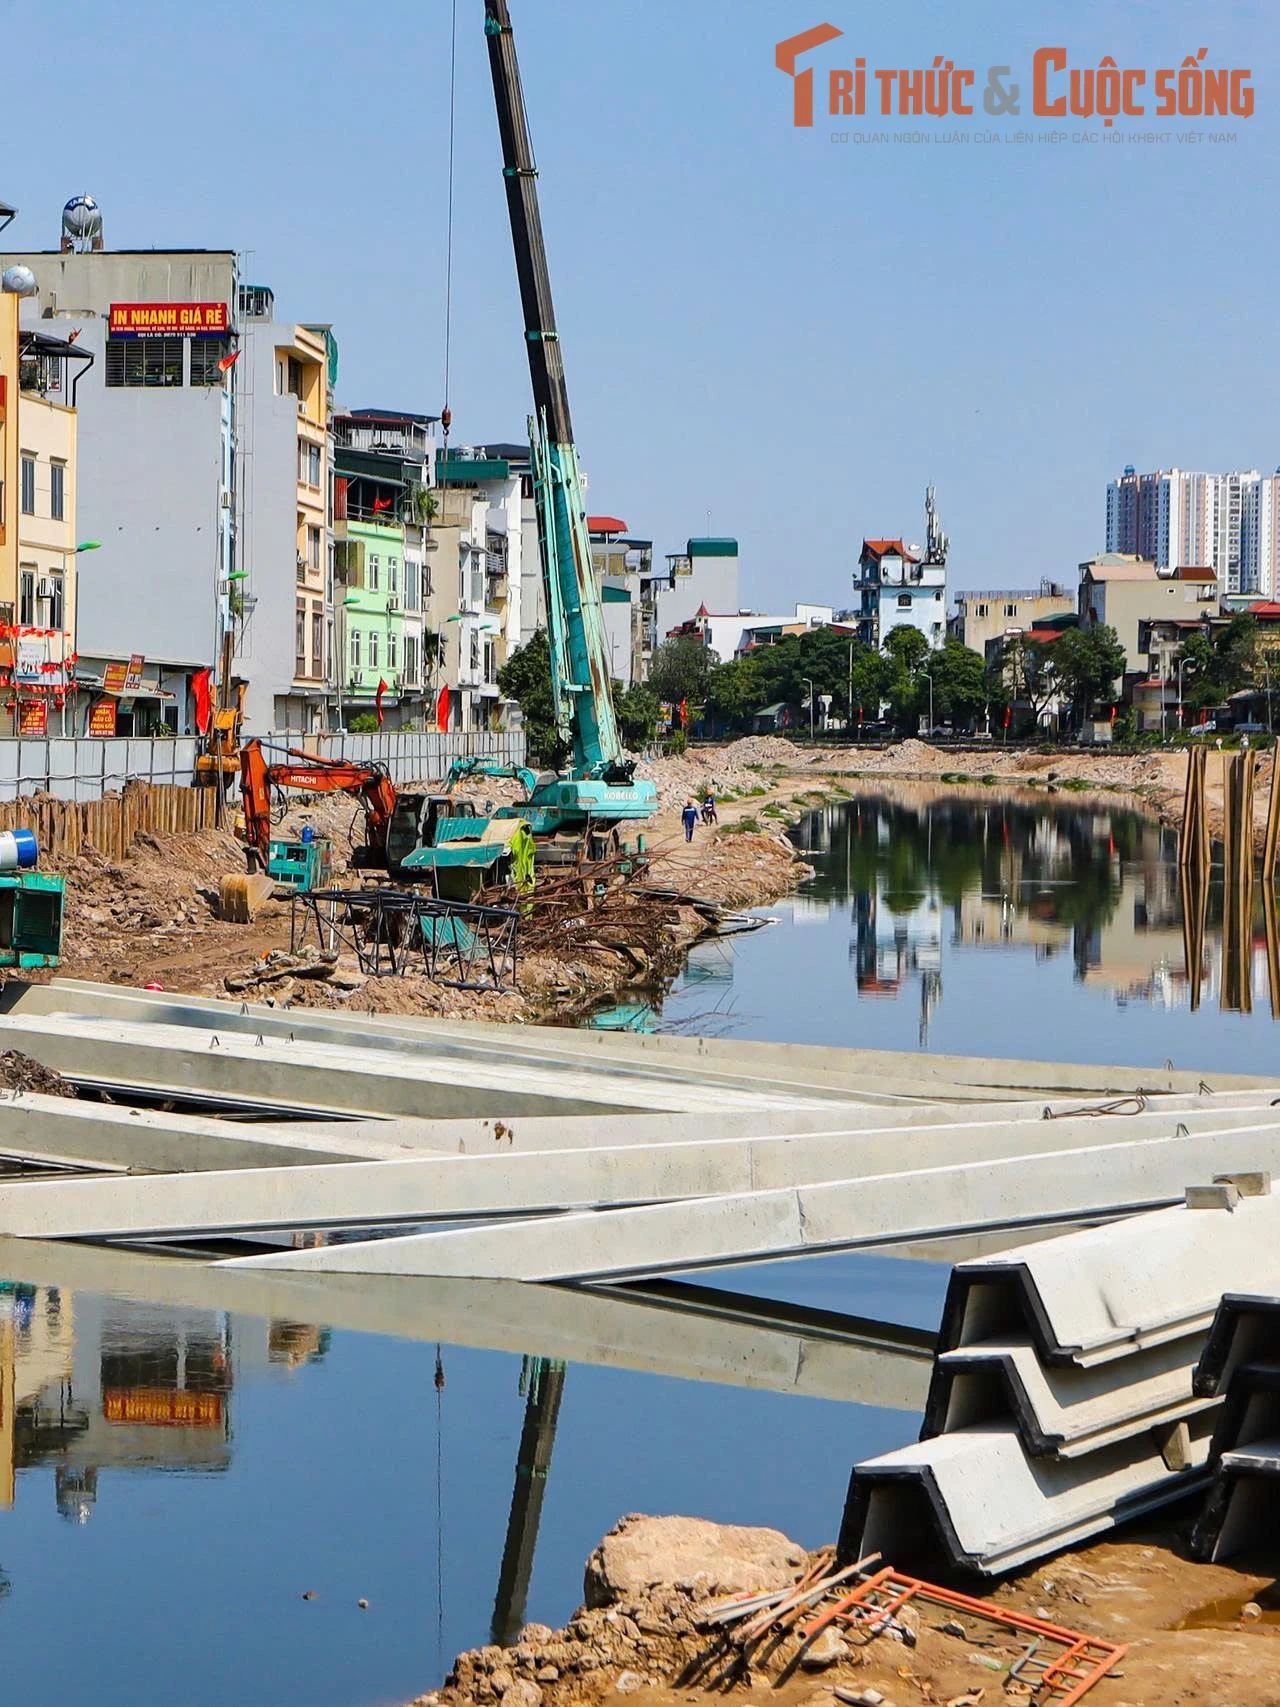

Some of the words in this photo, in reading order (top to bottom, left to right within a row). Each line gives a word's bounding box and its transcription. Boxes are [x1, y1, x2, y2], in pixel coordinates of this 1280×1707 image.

[113, 309, 128, 325] IN
[131, 309, 177, 325] NHANH
[180, 305, 202, 325] GIÁ
[205, 303, 223, 325] RẺ
[290, 775, 317, 785] HITACHI
[603, 790, 639, 800] KOBELCO
